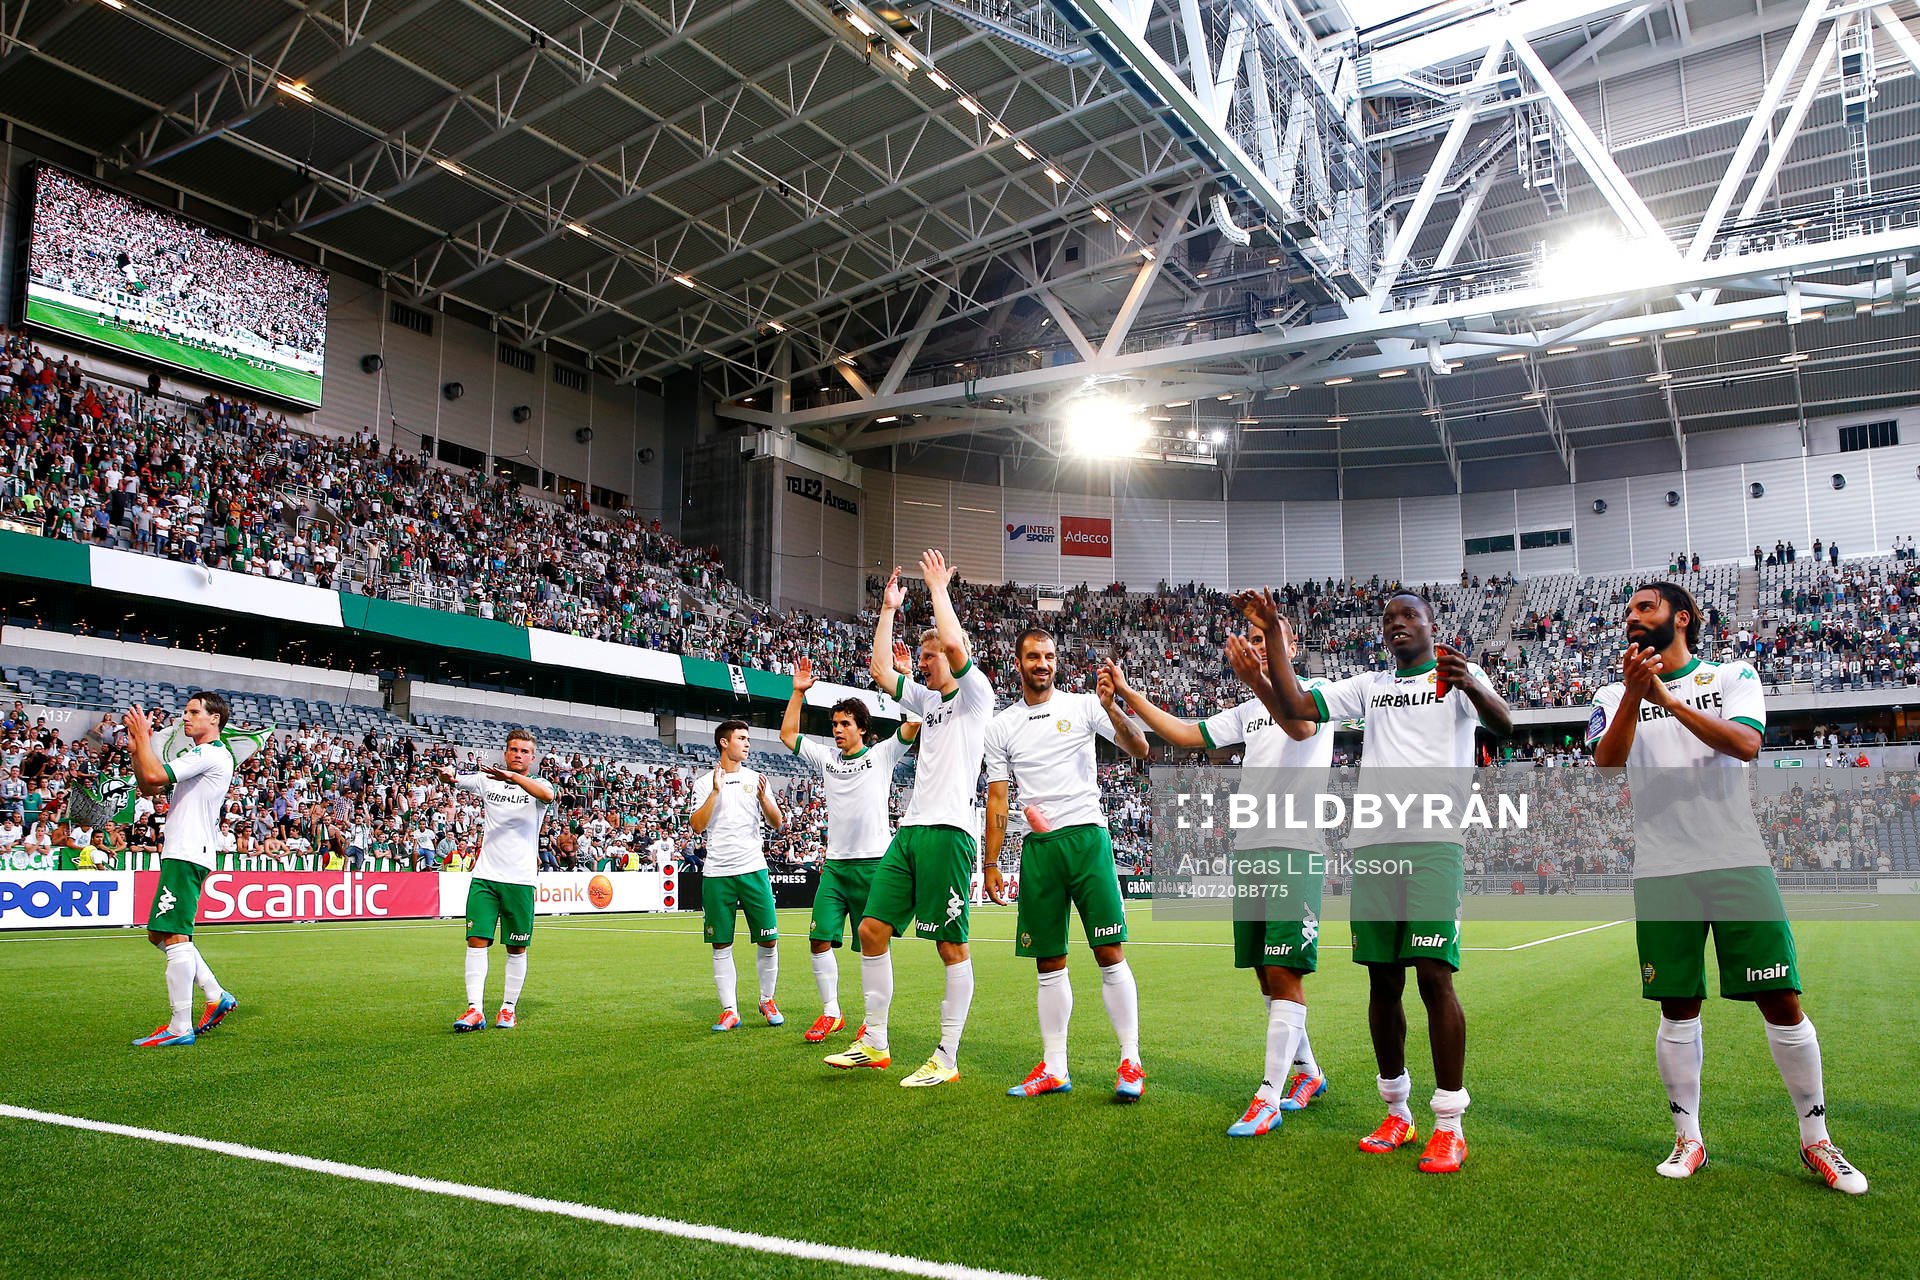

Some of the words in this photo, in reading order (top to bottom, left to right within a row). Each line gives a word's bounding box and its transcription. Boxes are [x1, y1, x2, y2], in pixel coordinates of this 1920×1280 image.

[785, 475, 822, 503] TELE2
[824, 489, 858, 515] Arena
[1026, 524, 1055, 534] INTER
[1026, 533, 1055, 543] SPORT
[1064, 530, 1109, 544] Adecco
[40, 709, 72, 722] A137
[768, 874, 807, 884] XPRESS
[203, 871, 388, 920] Scandic
[1094, 923, 1123, 938] Inair
[1411, 933, 1447, 948] Inair
[1746, 963, 1790, 982] Inair
